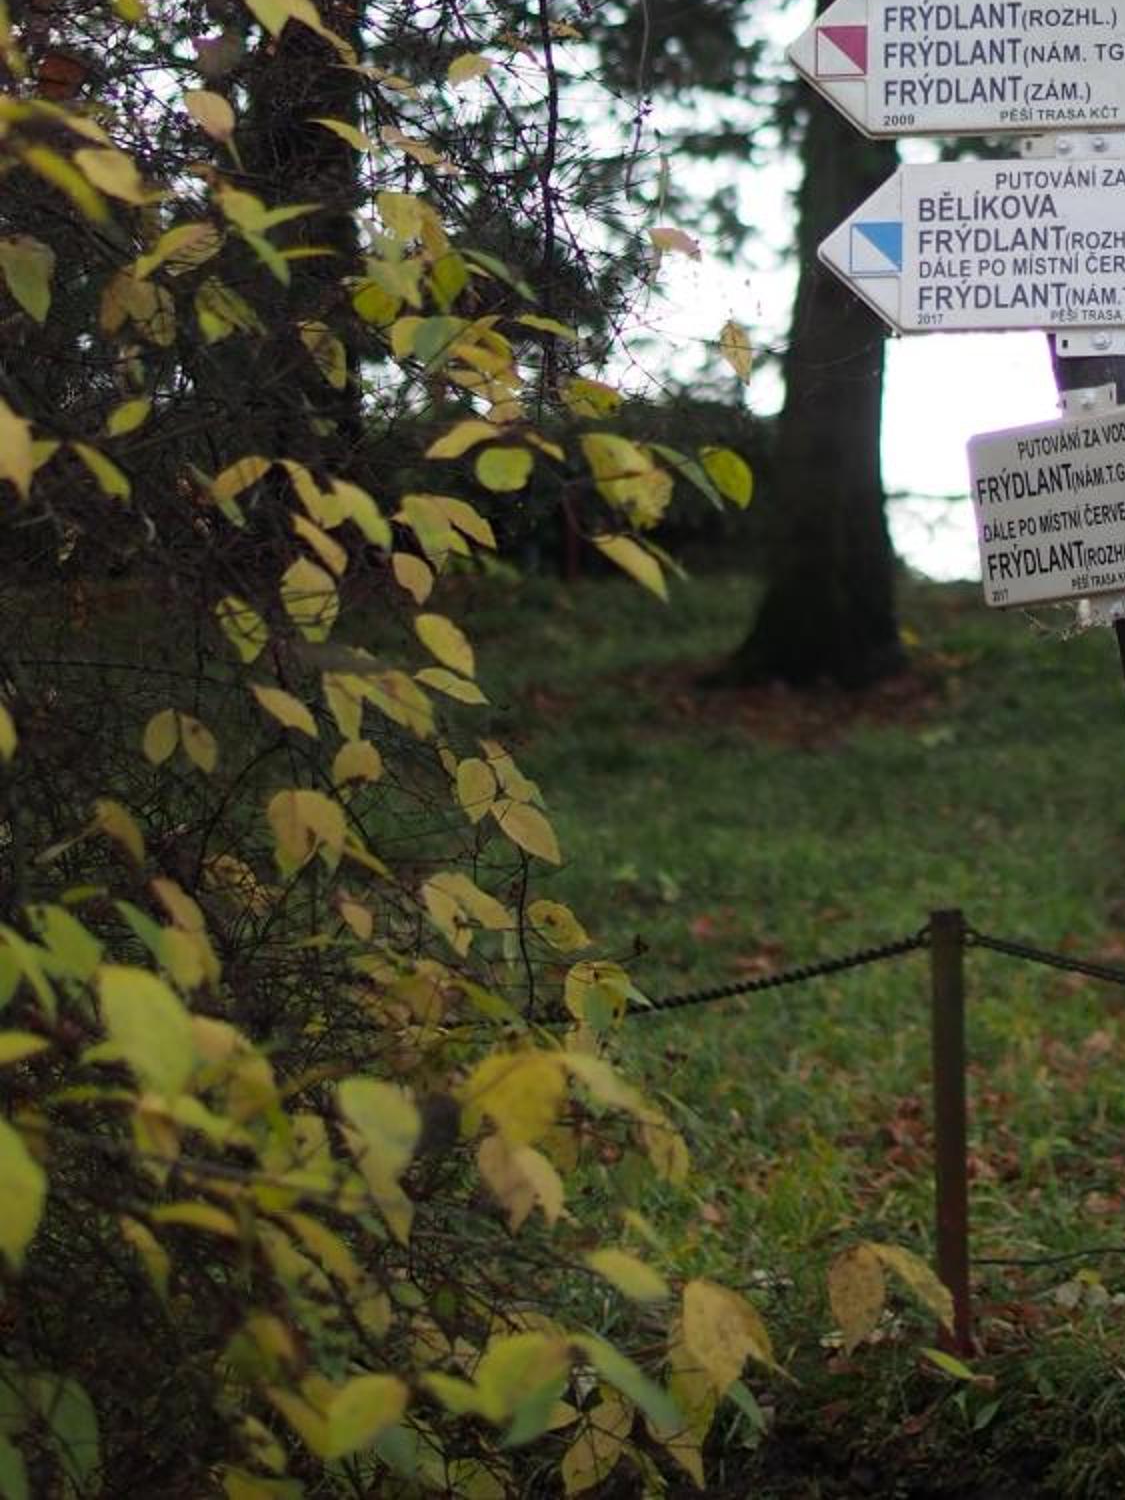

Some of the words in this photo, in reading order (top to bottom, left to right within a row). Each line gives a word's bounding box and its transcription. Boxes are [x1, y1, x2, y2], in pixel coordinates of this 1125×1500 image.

[1000, 106, 1035, 122] PĚŠÍ
[1038, 108, 1087, 120] TRASA
[1090, 104, 1118, 119] KČT
[996, 166, 1097, 190] PUTOVÁNÍ
[919, 191, 1057, 222] BĚLÍKOVA
[919, 255, 971, 279] DÁLE
[979, 258, 1004, 276] PO
[1012, 254, 1080, 276] MÍSTNÍ
[1051, 309, 1080, 323] PĚŠÍ
[1083, 308, 1122, 320] TRASA
[1017, 432, 1081, 460] PUTOVÁNÍ
[1083, 427, 1100, 446] ZA
[983, 520, 1015, 543] DÁLE
[1019, 516, 1037, 535] PO
[1039, 507, 1081, 533] MÍSTNÍ
[1091, 573, 1117, 587] TRASA
